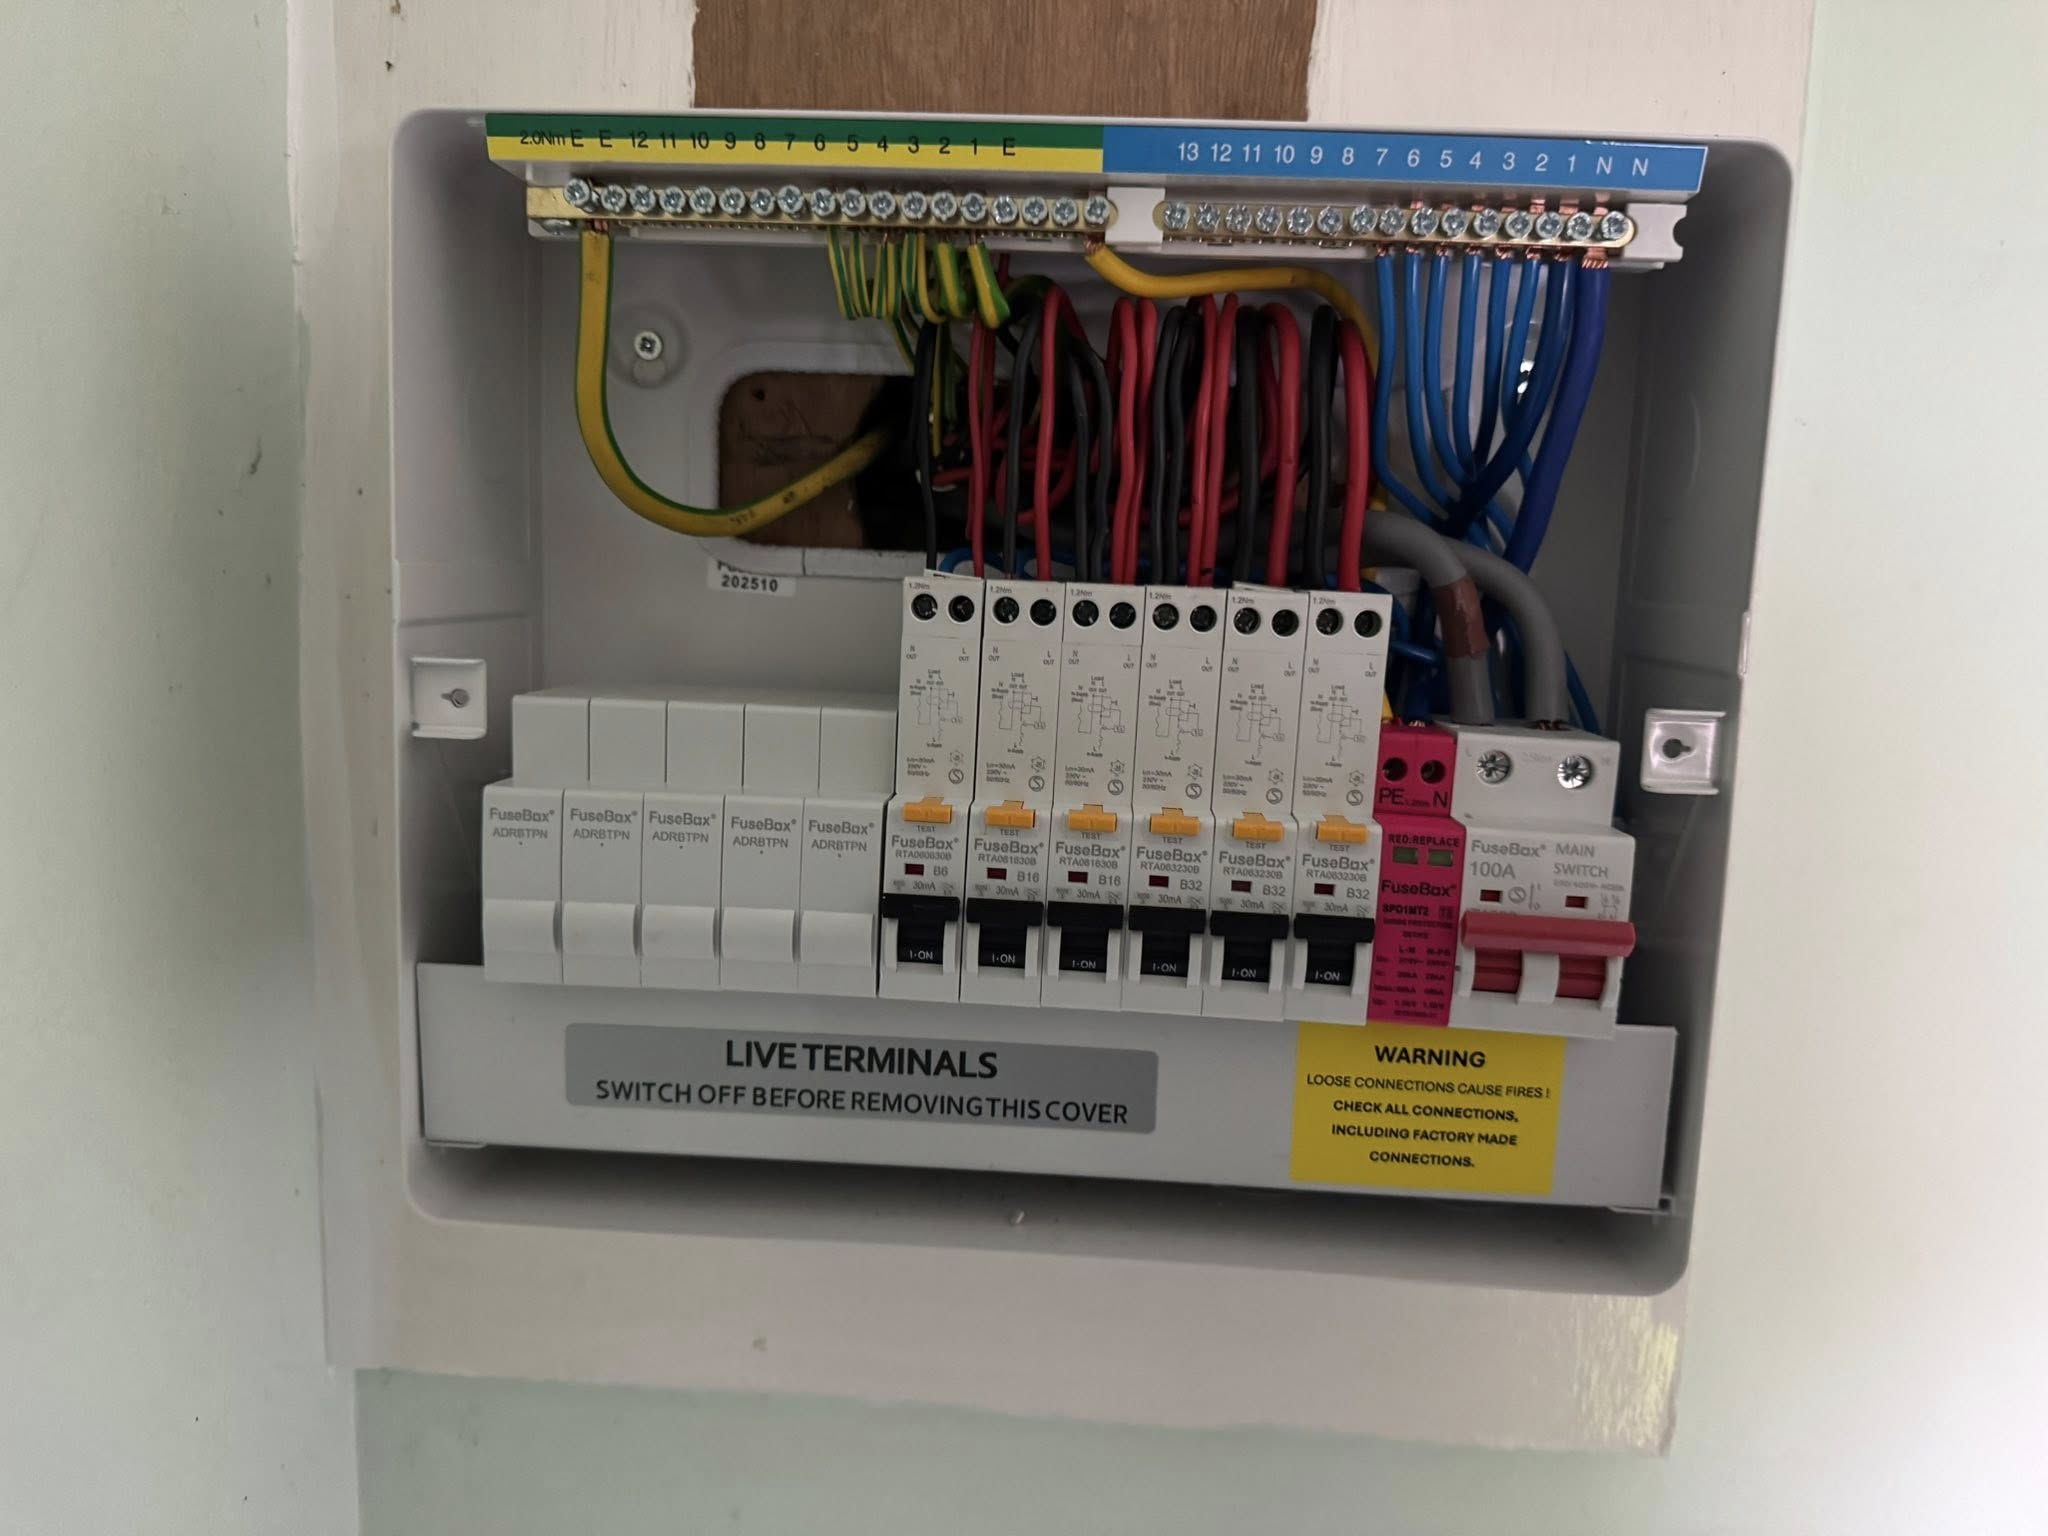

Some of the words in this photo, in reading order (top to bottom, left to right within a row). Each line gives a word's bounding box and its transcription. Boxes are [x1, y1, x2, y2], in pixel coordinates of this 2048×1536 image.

[520, 130, 566, 146] 2.0Nm
[570, 129, 584, 148] E
[600, 130, 612, 148] E
[631, 131, 648, 148] 12
[661, 132, 676, 149] 11
[691, 132, 709, 149] 10
[725, 133, 736, 150] 9
[754, 133, 766, 150] 8
[785, 133, 796, 150] 7
[814, 134, 826, 151] 6
[847, 135, 859, 152] 5
[877, 135, 889, 152] 4
[908, 136, 919, 153] 3
[939, 137, 950, 154] 2
[1003, 138, 1015, 156] E
[1178, 142, 1199, 161] 13
[1210, 143, 1232, 162] 12
[1243, 144, 1261, 163] 11
[1274, 145, 1295, 164] 10
[1310, 146, 1323, 164] 9
[1342, 147, 1354, 165] 8
[1376, 148, 1388, 166] 7
[1407, 149, 1420, 167] 6
[1440, 150, 1453, 168] 5
[1469, 151, 1482, 169] 4
[1502, 152, 1515, 170] 3
[1535, 153, 1548, 171] 2
[1568, 155, 1576, 172] 1
[1596, 156, 1613, 175] N
[1632, 158, 1648, 176] N
[721, 575, 778, 592] 202510
[1379, 787, 1404, 805] PE
[1434, 791, 1448, 808] N
[493, 828, 548, 839] ADRBTPN
[573, 829, 630, 840] ADRBTPN
[917, 825, 936, 833] TEST
[1000, 829, 1019, 837] TEST
[652, 831, 708, 843] ADRBTPN
[733, 836, 789, 848] ADRBTPN
[1081, 832, 1101, 840] TEST
[1163, 837, 1182, 845] TEST
[811, 839, 867, 851] ADRBTPN
[1246, 842, 1266, 850] TEST
[1329, 844, 1349, 852] TEST
[1555, 843, 1595, 858] MAIN
[933, 865, 948, 876] B6
[1470, 862, 1516, 879] 100A
[1553, 863, 1608, 878] SWITCH
[1017, 871, 1039, 883] B16
[1099, 874, 1121, 886] B16
[913, 881, 936, 890] 30mA
[996, 886, 1019, 897] 30mA
[1180, 880, 1202, 891] B32
[1263, 885, 1286, 897] B32
[1077, 890, 1100, 900] 30mA
[1158, 894, 1182, 904] 30mA
[1346, 888, 1370, 900] B32
[1241, 900, 1264, 910] 30mA
[1324, 903, 1348, 913] 30mA
[726, 1040, 797, 1069] LIVE
[802, 1044, 997, 1079] TERMINALS
[1374, 1045, 1486, 1068] WARNING
[1307, 1073, 1350, 1087] LOOSE
[1354, 1077, 1454, 1094] CONNECTIONS
[1458, 1083, 1502, 1097] CAUSE
[1505, 1086, 1542, 1099] FIRES
[596, 1079, 691, 1104] SWITCH
[698, 1083, 746, 1105] OFF
[753, 1086, 845, 1110] BEFORE
[851, 1091, 983, 1117] REMOVING
[983, 1097, 1041, 1120] THIS
[1045, 1100, 1128, 1124] COVER
[1333, 1100, 1382, 1114] CHECK
[1385, 1103, 1409, 1116] ALL
[1332, 1124, 1410, 1140] INCLUDING
[1413, 1129, 1475, 1144] FACTORY
[1478, 1133, 1518, 1146] MADE
